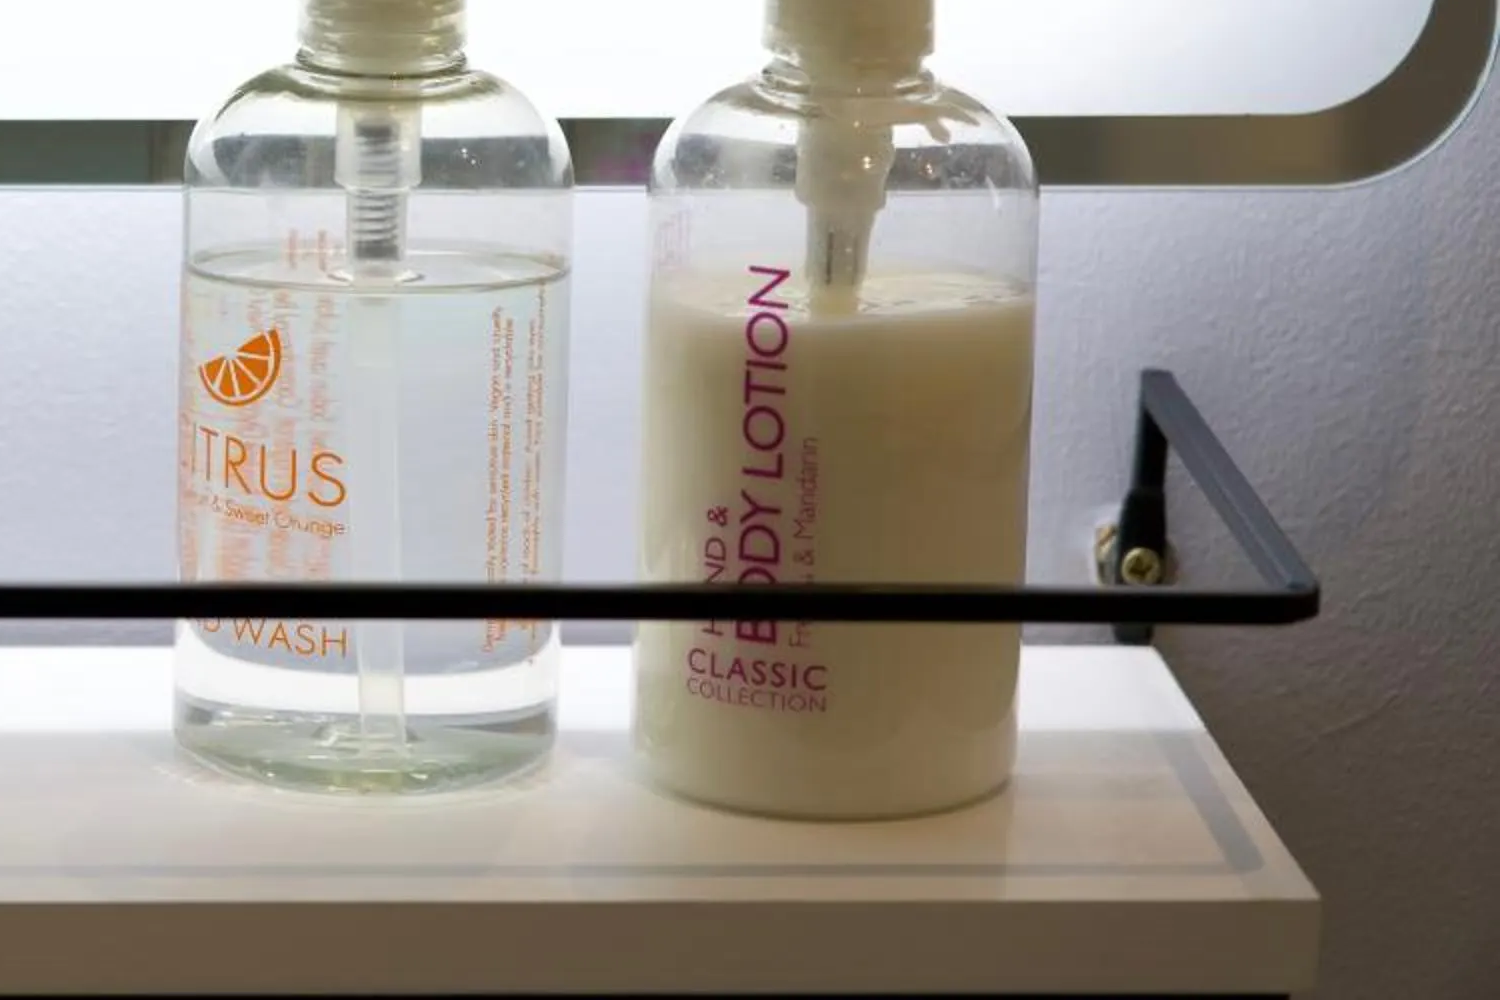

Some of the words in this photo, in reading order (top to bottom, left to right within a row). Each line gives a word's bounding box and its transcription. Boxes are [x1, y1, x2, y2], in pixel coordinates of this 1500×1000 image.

[742, 265, 791, 480] LOTION
[707, 506, 730, 527] &
[702, 537, 726, 637] HND
[232, 616, 348, 659] WASH
[688, 648, 829, 692] CLASSIC
[687, 677, 828, 714] COLLECTION
